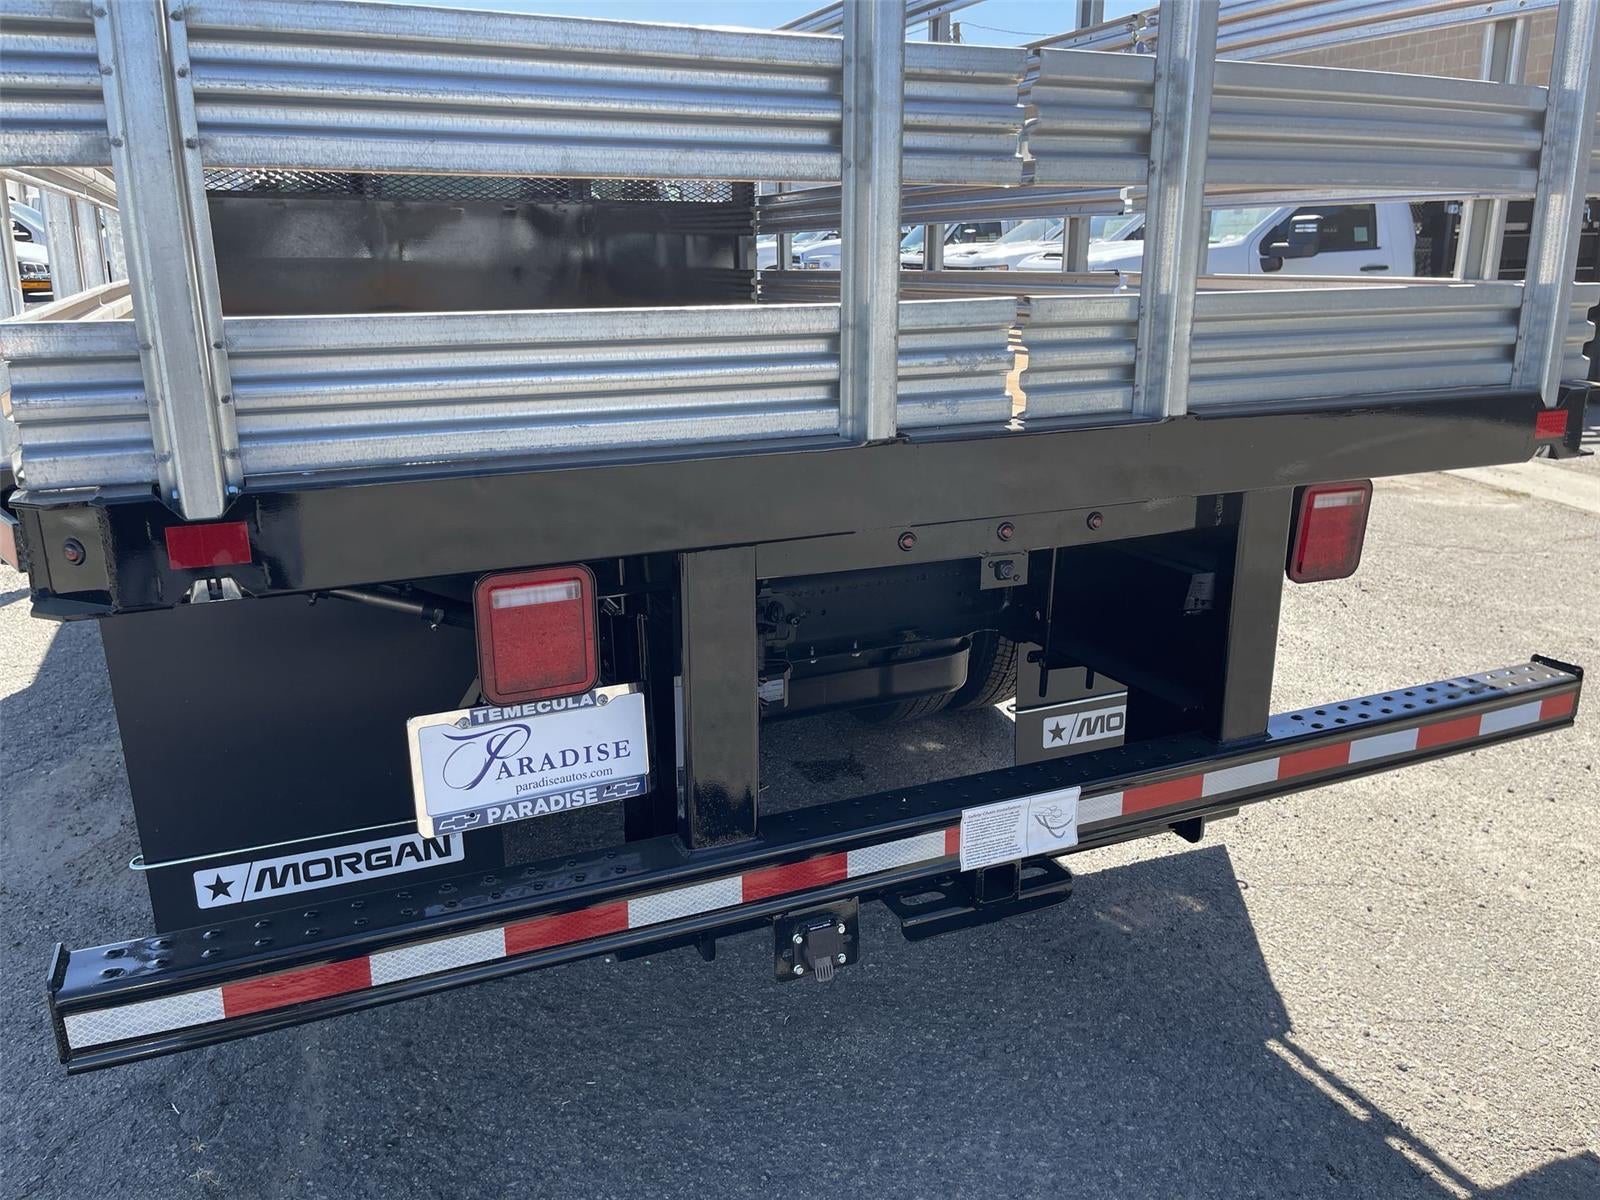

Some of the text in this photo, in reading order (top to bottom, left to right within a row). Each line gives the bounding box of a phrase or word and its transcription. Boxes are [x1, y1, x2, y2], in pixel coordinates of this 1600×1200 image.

[473, 693, 594, 723] TEMECULA
[442, 723, 632, 791] PARADISE
[515, 766, 613, 796] paradiseautos.com
[486, 787, 598, 825] PARADISE
[254, 837, 451, 892] MORGAN
